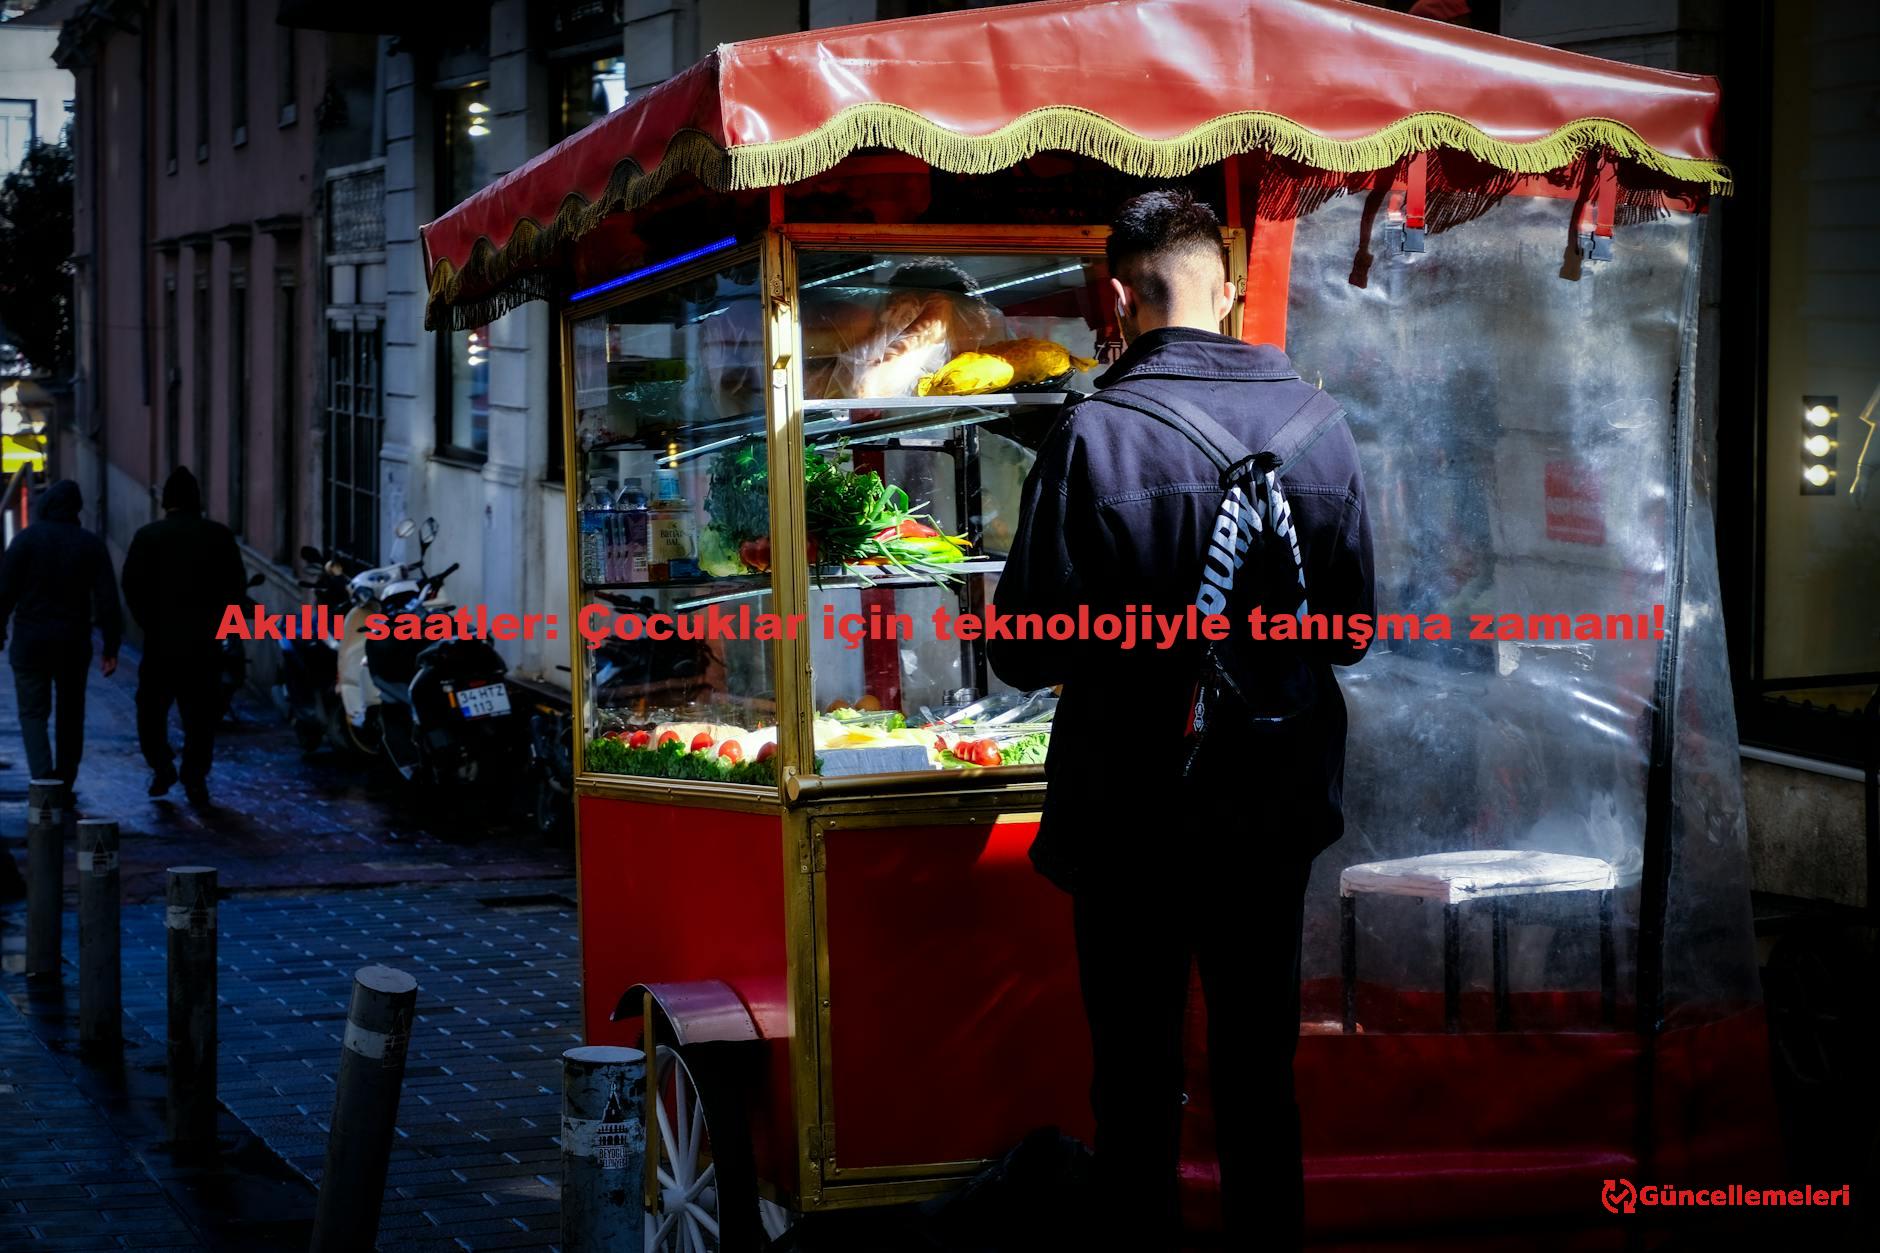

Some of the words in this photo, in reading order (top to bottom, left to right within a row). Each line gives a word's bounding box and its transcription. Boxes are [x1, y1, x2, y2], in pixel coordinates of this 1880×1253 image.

[460, 691, 477, 704] 34
[479, 685, 504, 699] HTZ
[473, 700, 494, 713] 113
